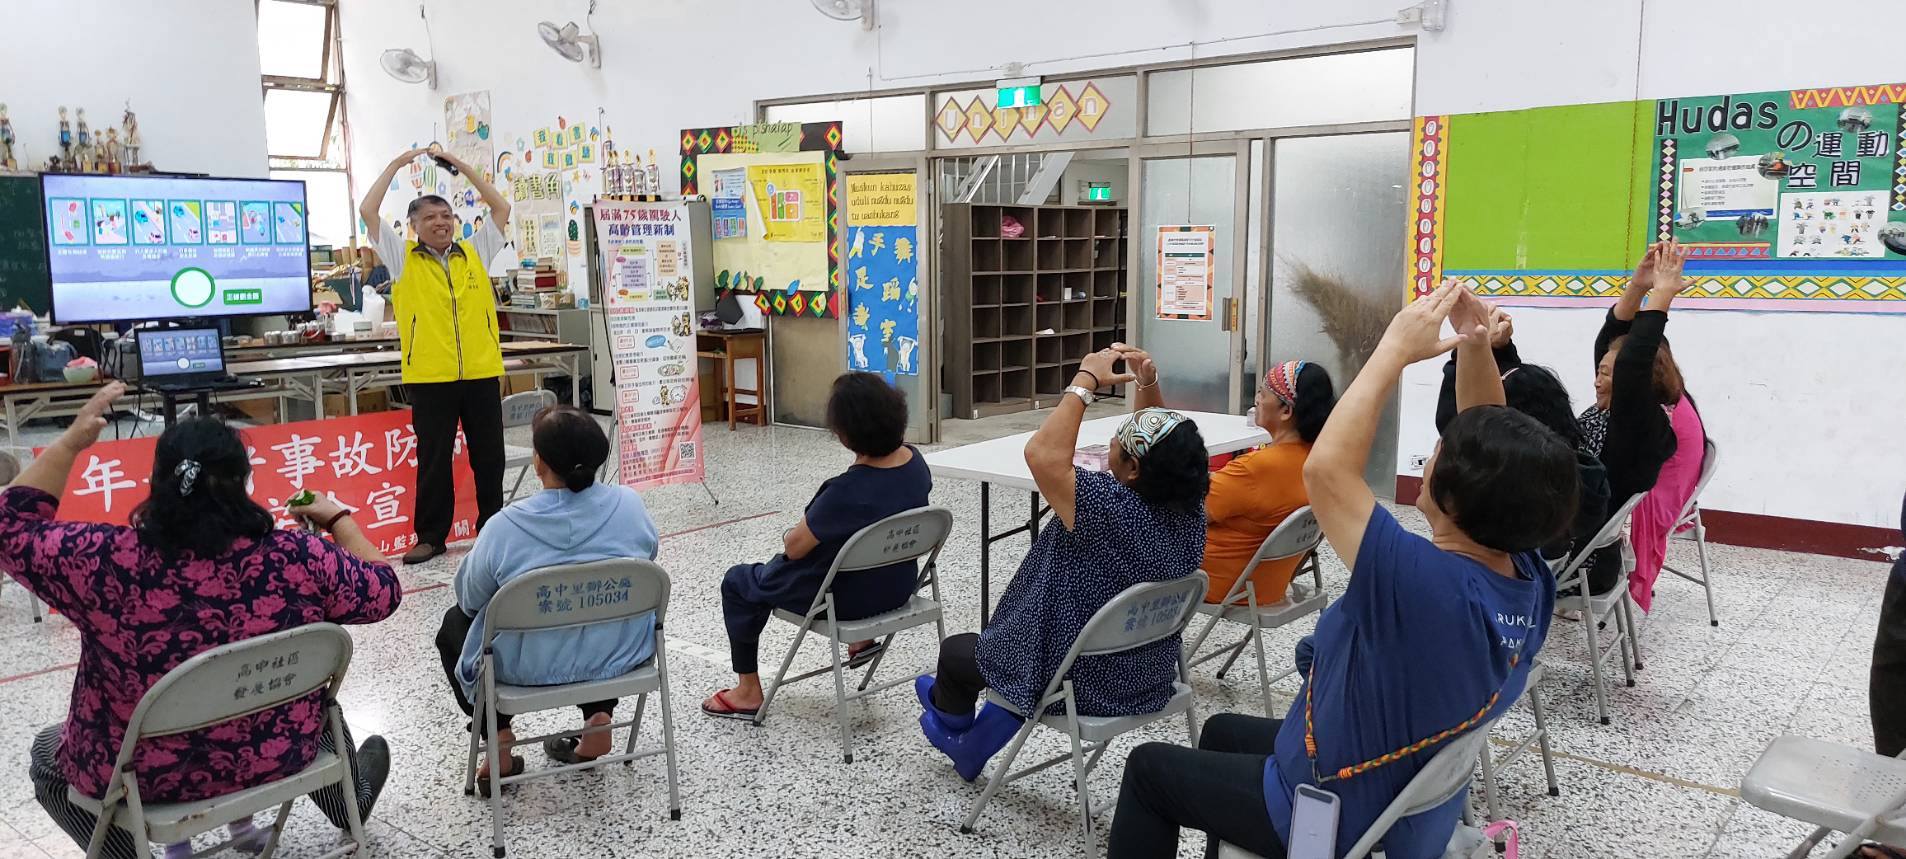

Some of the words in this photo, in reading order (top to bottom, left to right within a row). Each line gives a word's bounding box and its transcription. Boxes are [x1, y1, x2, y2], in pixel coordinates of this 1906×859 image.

[1656, 95, 1779, 136] Hudas
[1776, 120, 1889, 158] の運動
[1786, 160, 1861, 188] 空間
[608, 223, 675, 236] 高齡管理新制
